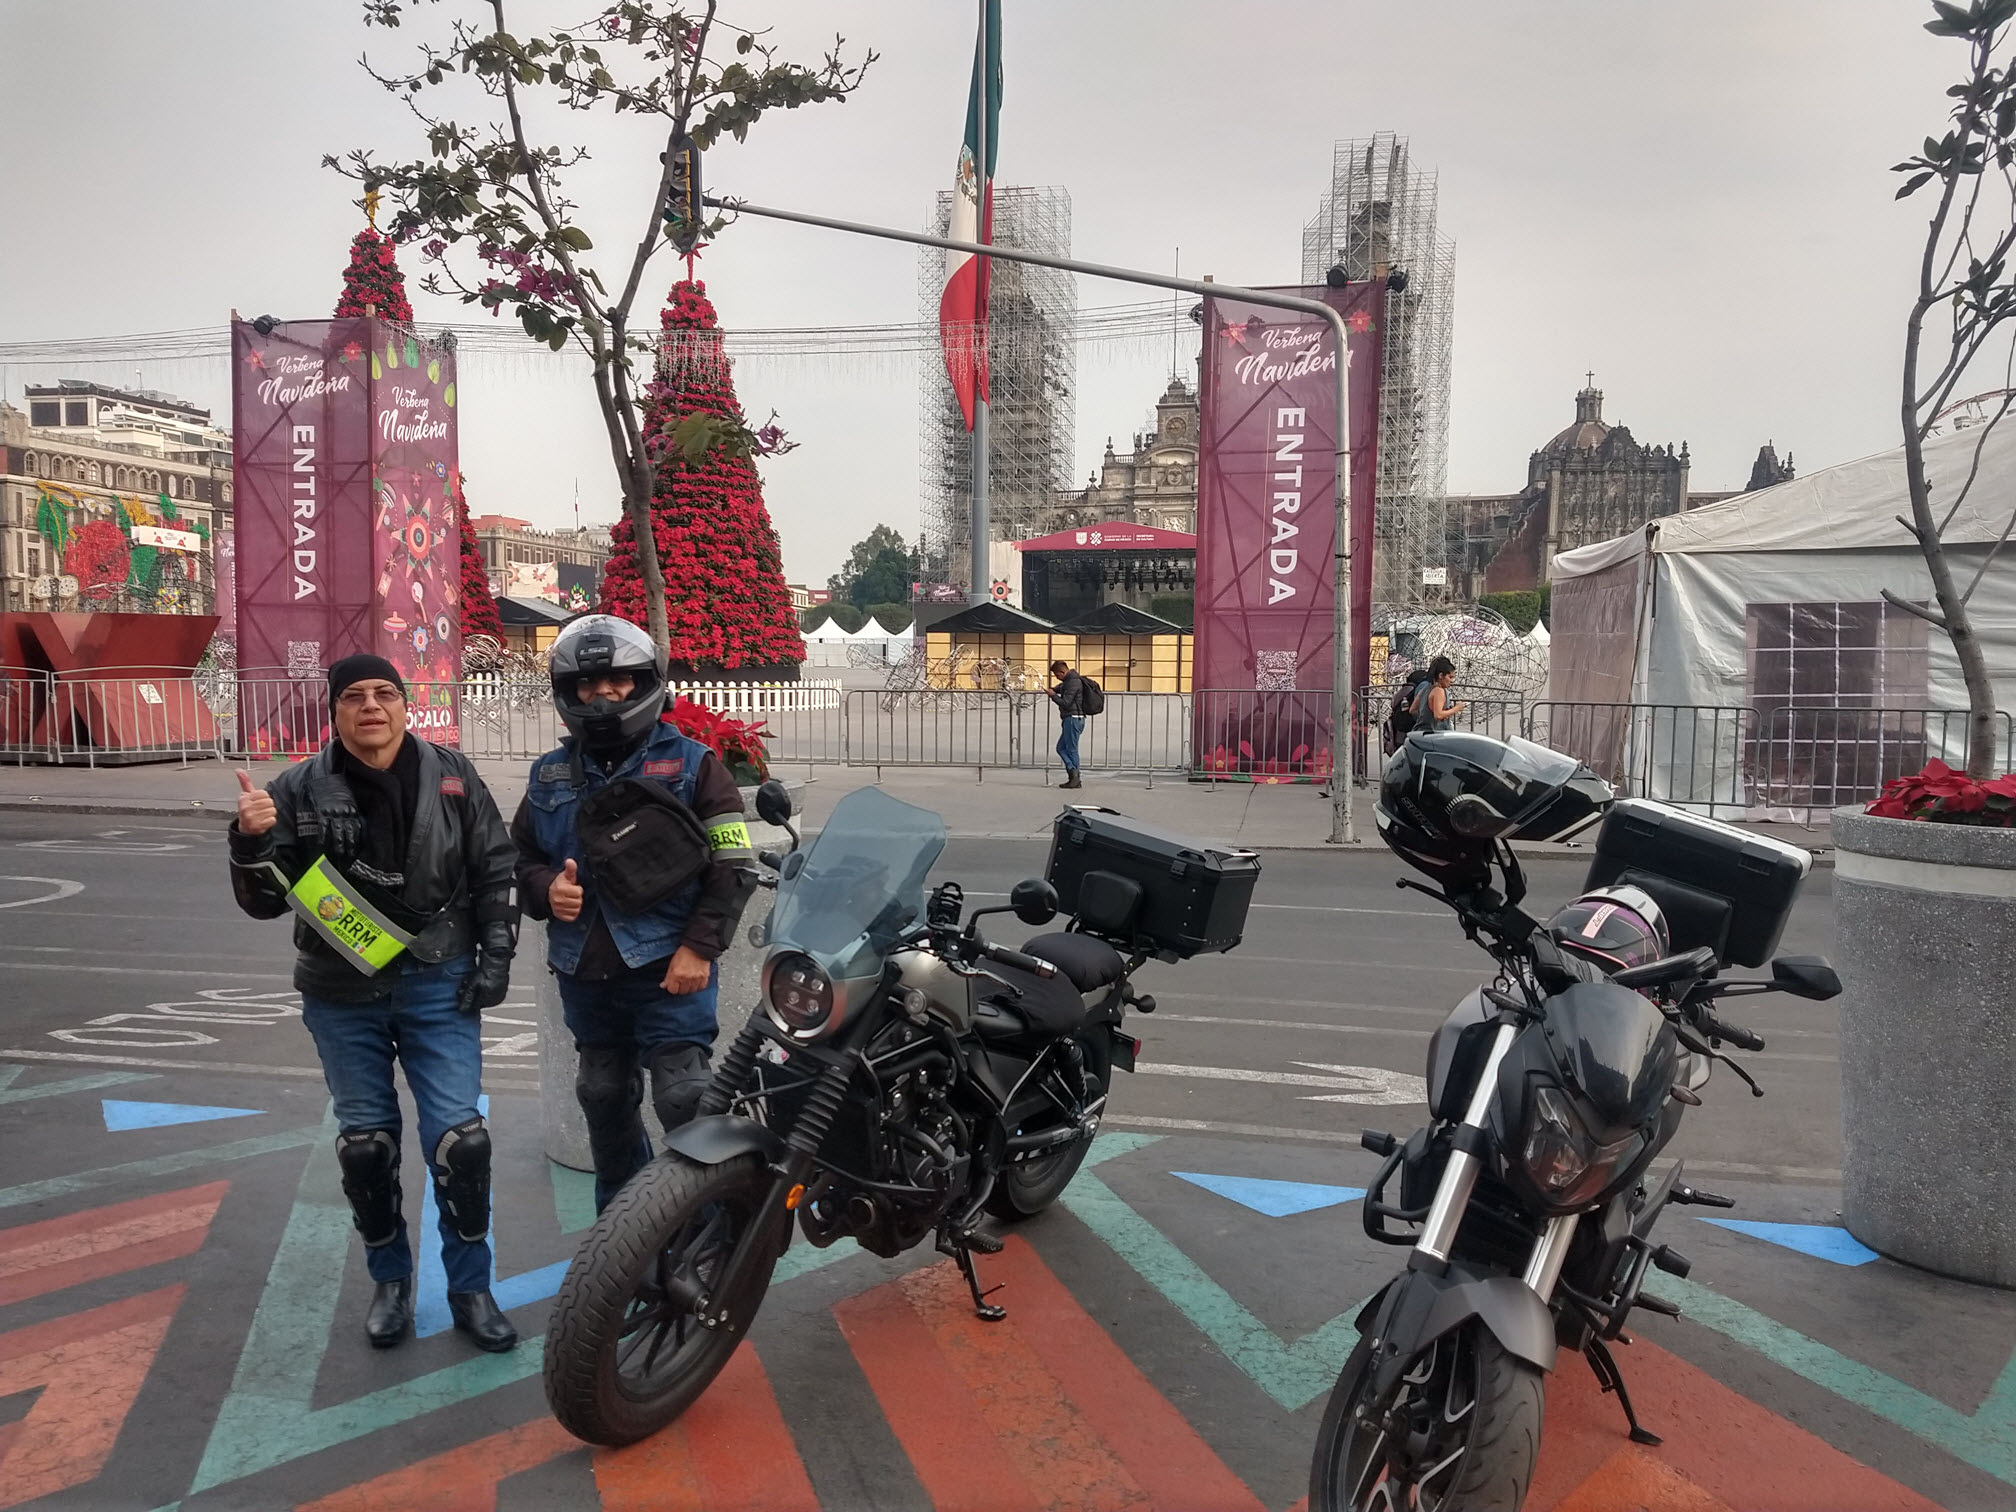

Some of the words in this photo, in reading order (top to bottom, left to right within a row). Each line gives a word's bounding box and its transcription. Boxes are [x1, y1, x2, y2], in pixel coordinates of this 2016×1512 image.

[1261, 327, 1322, 348] Verbena
[277, 355, 324, 374] Verbena
[1234, 344, 1354, 385] Navideñ
[257, 370, 350, 405] Navideña
[392, 387, 429, 409] Verbena
[379, 410, 447, 443] Navideña
[293, 425, 317, 600] ENTRADA
[1268, 407, 1306, 605] ENTRADA
[405, 704, 451, 731] ÓCALO
[710, 828, 745, 847] RRM
[338, 913, 378, 948] RRM
[350, 907, 383, 936] MOTOTURISTA
